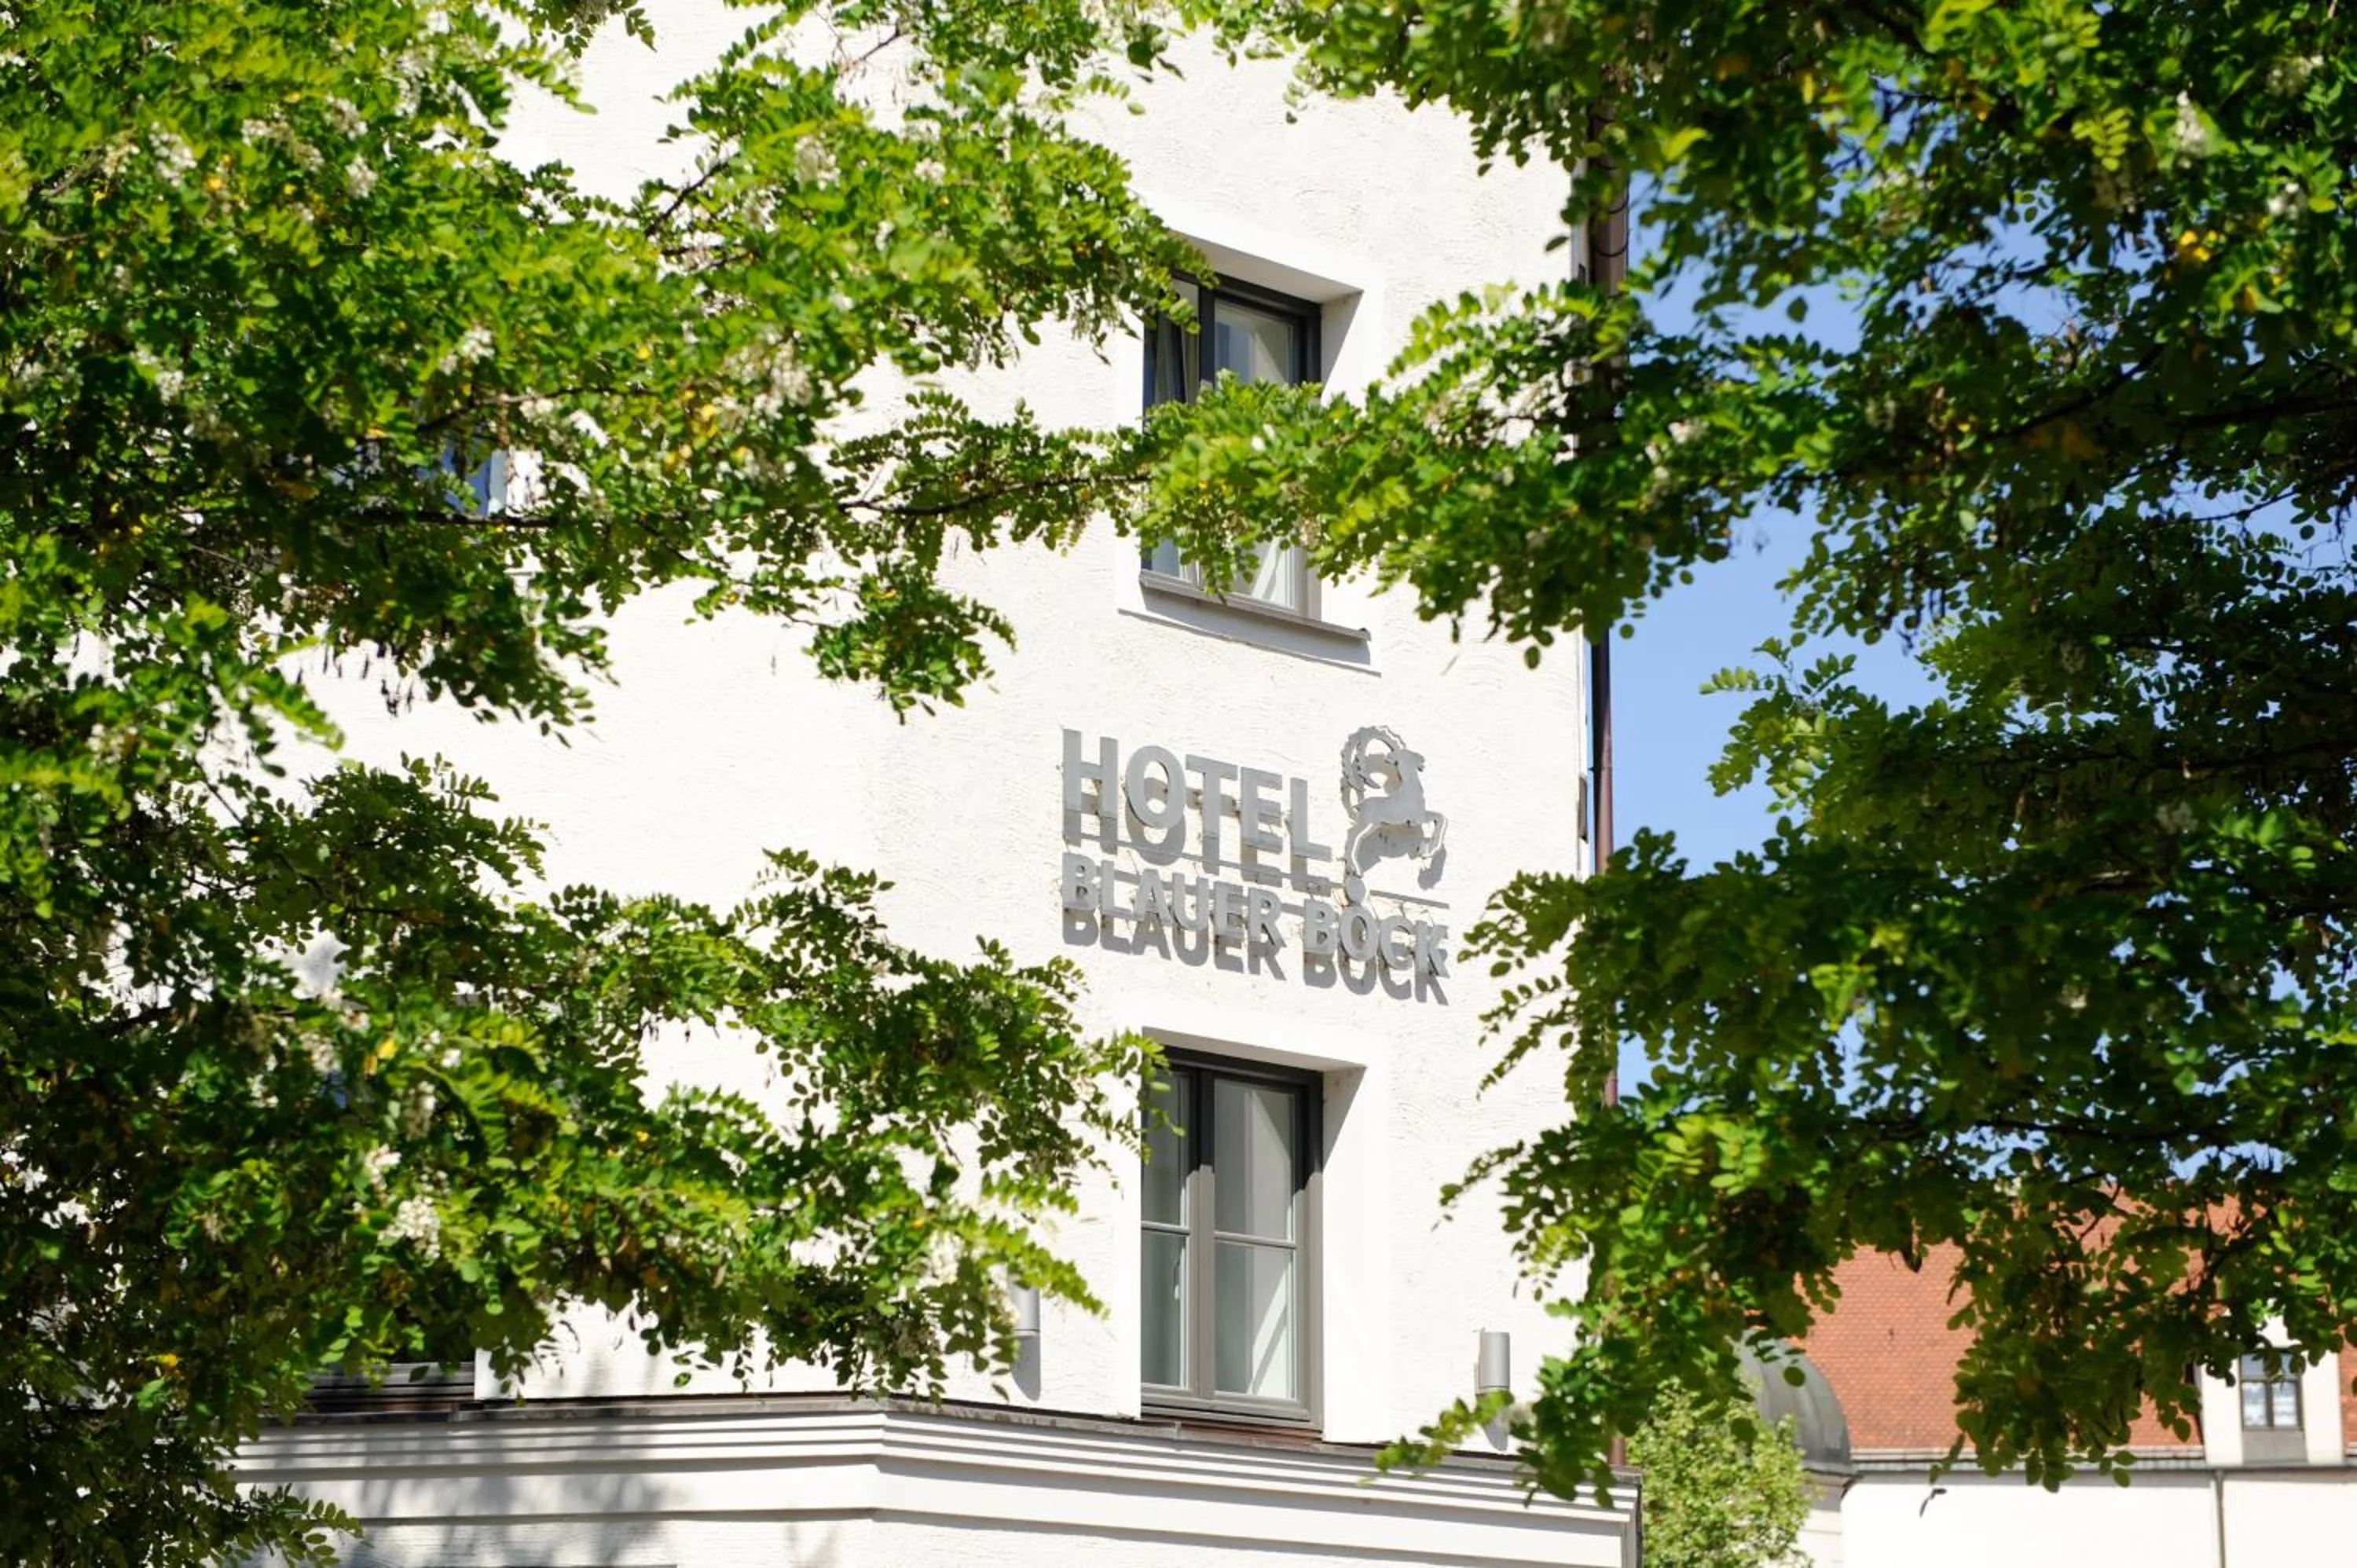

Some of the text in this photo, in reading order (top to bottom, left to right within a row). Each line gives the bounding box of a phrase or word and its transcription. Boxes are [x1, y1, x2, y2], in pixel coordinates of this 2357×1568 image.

[1062, 728, 1332, 862] HOTEL
[1062, 852, 1450, 978] BLAUER BOCK
